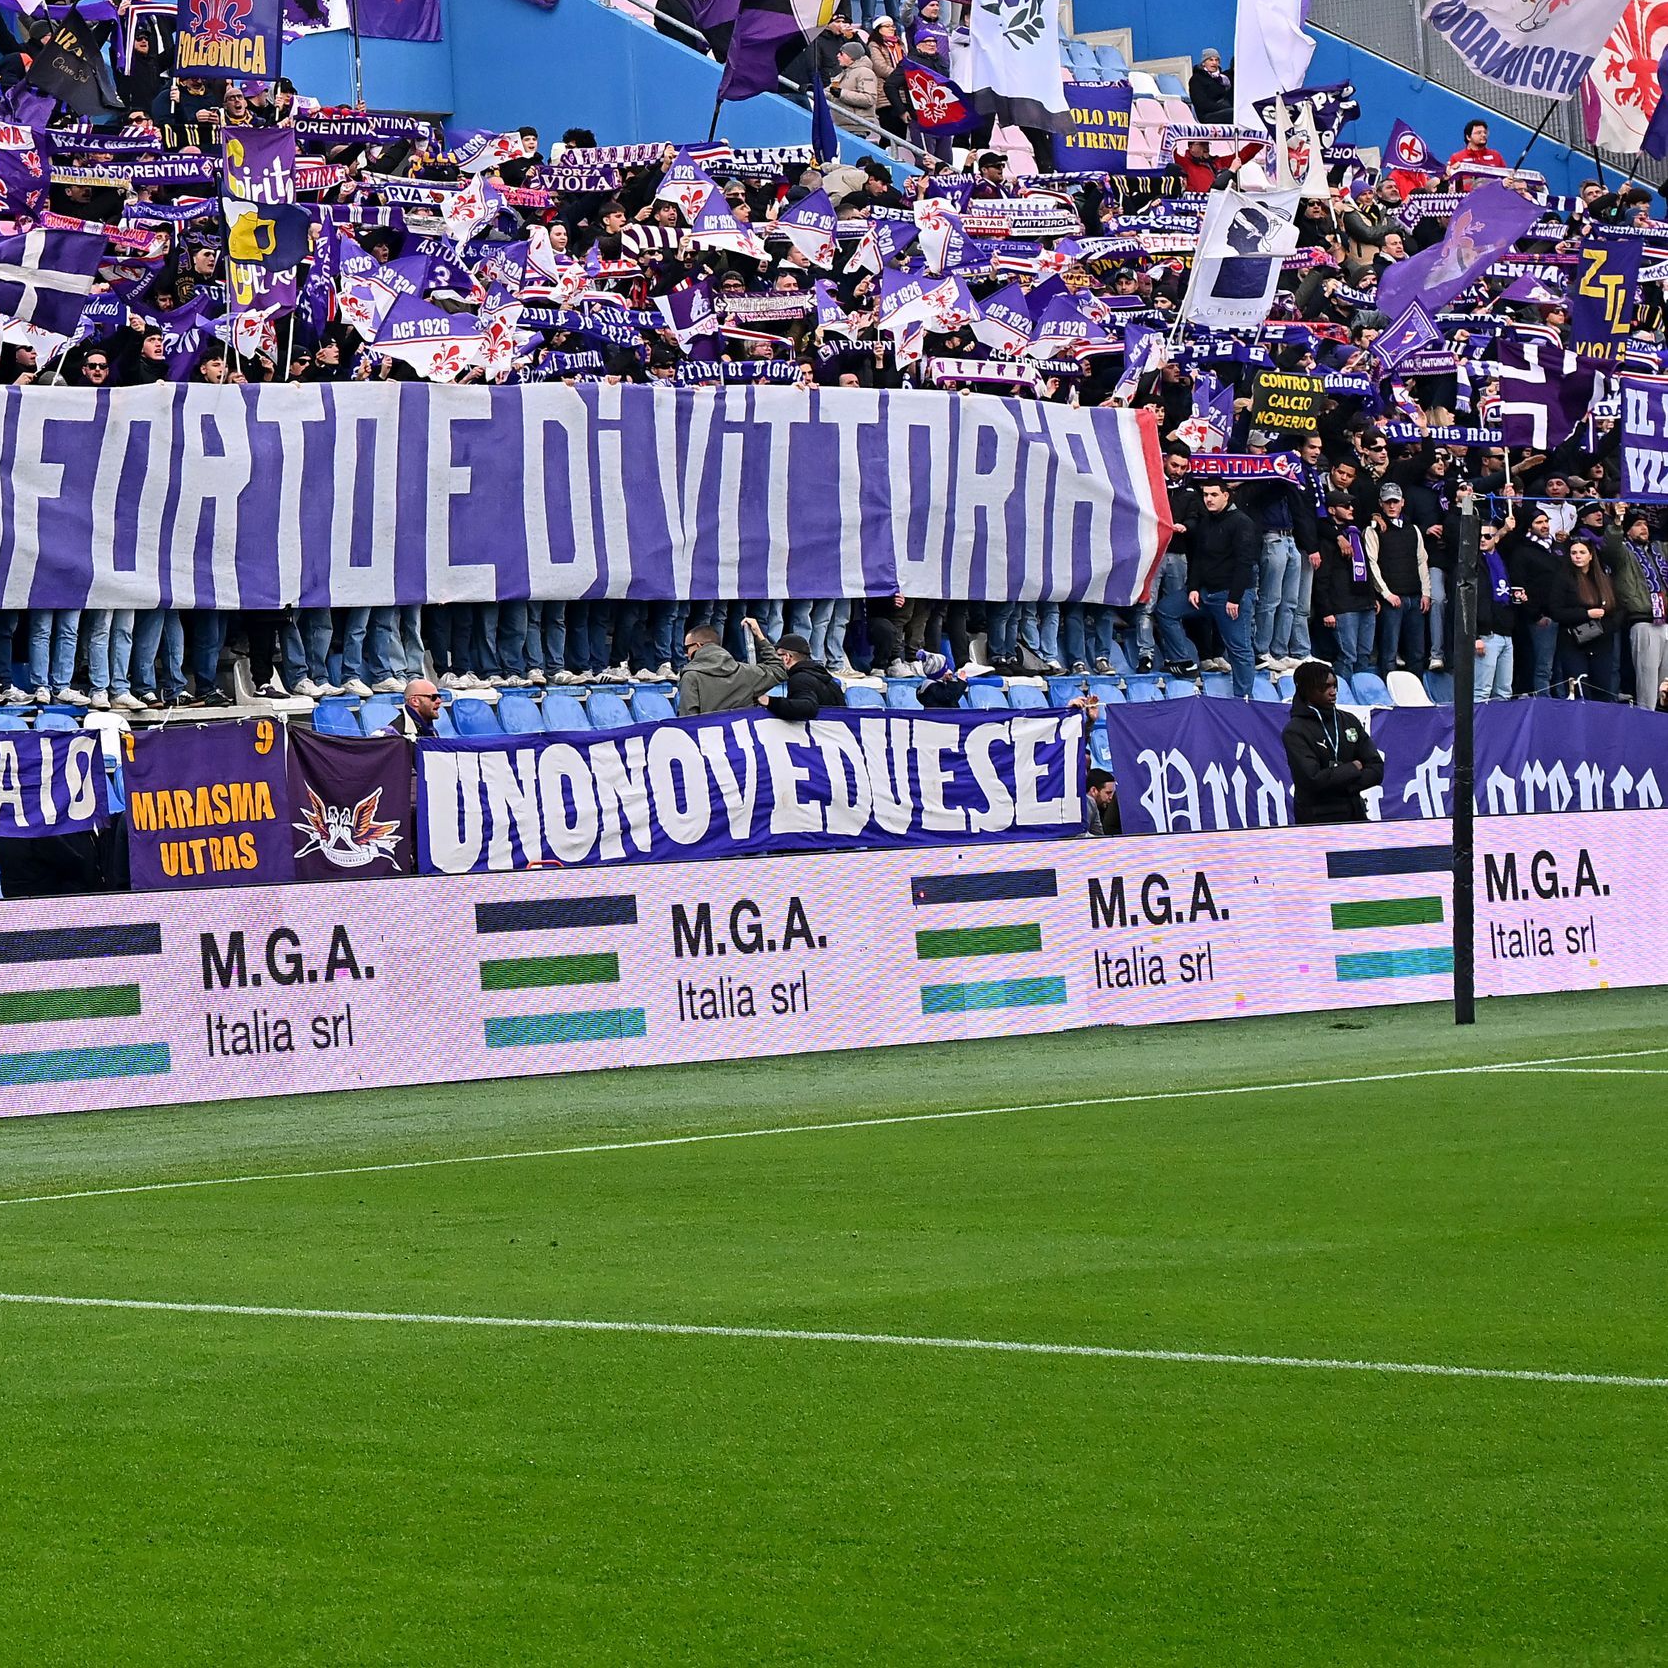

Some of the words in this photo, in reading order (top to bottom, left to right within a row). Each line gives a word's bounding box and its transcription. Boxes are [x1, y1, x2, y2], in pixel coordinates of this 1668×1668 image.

[178, 31, 267, 74] FOLLONICA
[546, 175, 619, 192] VIOLA
[552, 167, 601, 180] FORZA
[1578, 248, 1631, 335] ZTL
[390, 320, 420, 337] ACF
[423, 317, 450, 334] 1926
[1259, 374, 1312, 392] CONTRO
[1267, 393, 1312, 410] CALCIO
[1254, 410, 1318, 432] MODERNO
[422, 376, 493, 612] E
[131, 781, 275, 832] MARASMA
[421, 712, 1084, 874] UNONOVEDUESEI
[1137, 742, 1297, 831] Prid
[160, 832, 258, 878] ULTRAS
[1485, 849, 1611, 901] M.G.A.
[1088, 872, 1231, 930] M.G.A.
[673, 897, 828, 959] M.G.A.
[1490, 919, 1554, 960] Italia
[1565, 916, 1597, 955] srl
[202, 925, 376, 992] M.G.A.
[1094, 946, 1167, 990] Italia
[1178, 943, 1213, 985] srl
[677, 979, 753, 1023] Italia
[771, 971, 809, 1015] srl
[207, 1010, 292, 1058] Italia
[312, 1004, 356, 1049] srl
